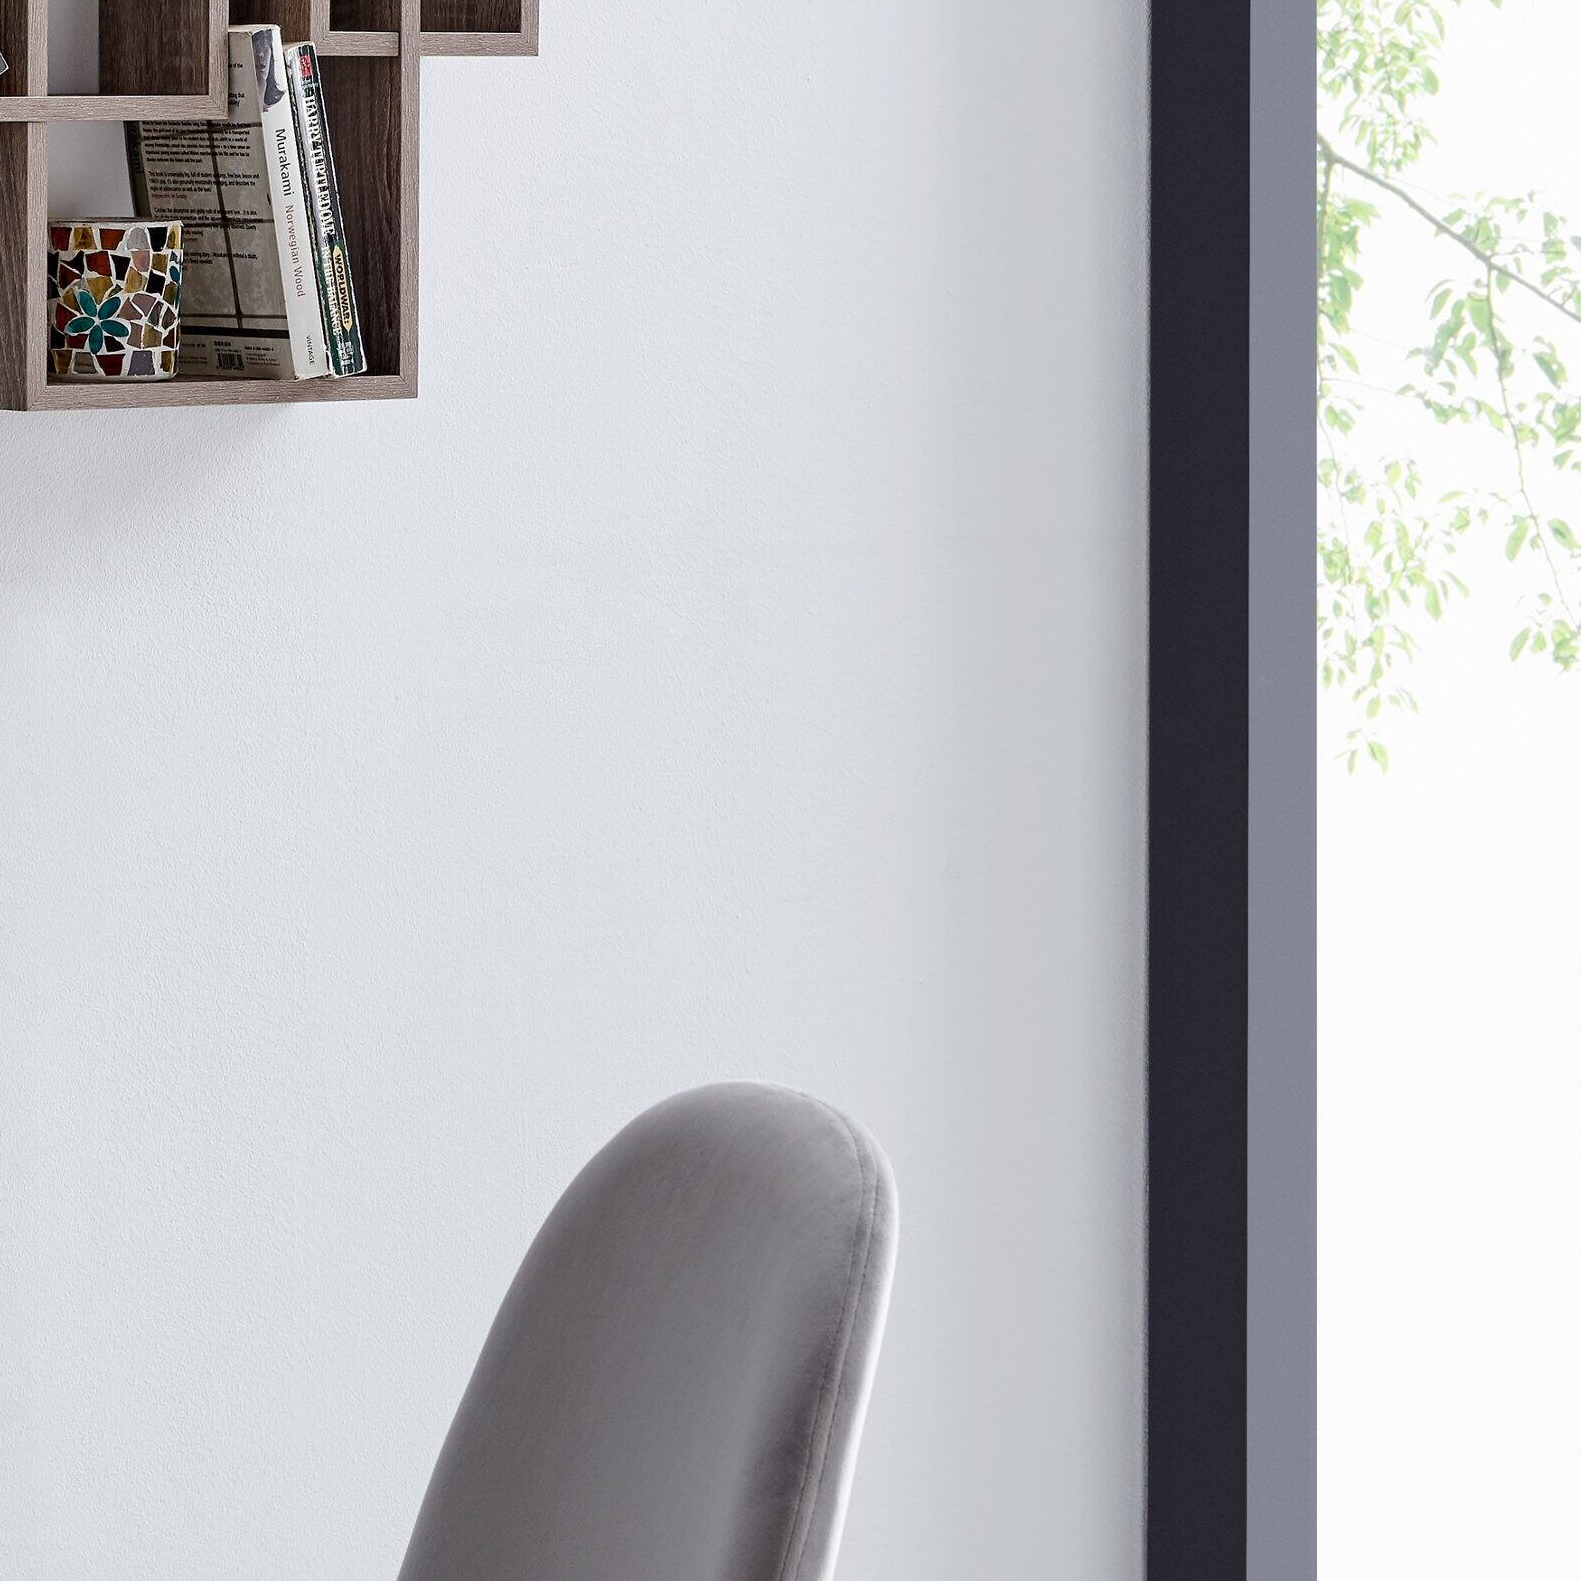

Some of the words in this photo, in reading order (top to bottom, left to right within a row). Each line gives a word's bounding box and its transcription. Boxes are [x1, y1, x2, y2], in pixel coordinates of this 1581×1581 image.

[275, 127, 296, 198] Murakami
[285, 204, 299, 266] Norwegian
[293, 265, 306, 298] Wood
[334, 253, 350, 325] WORLDWAR:
[306, 335, 315, 365] VINTAGE
